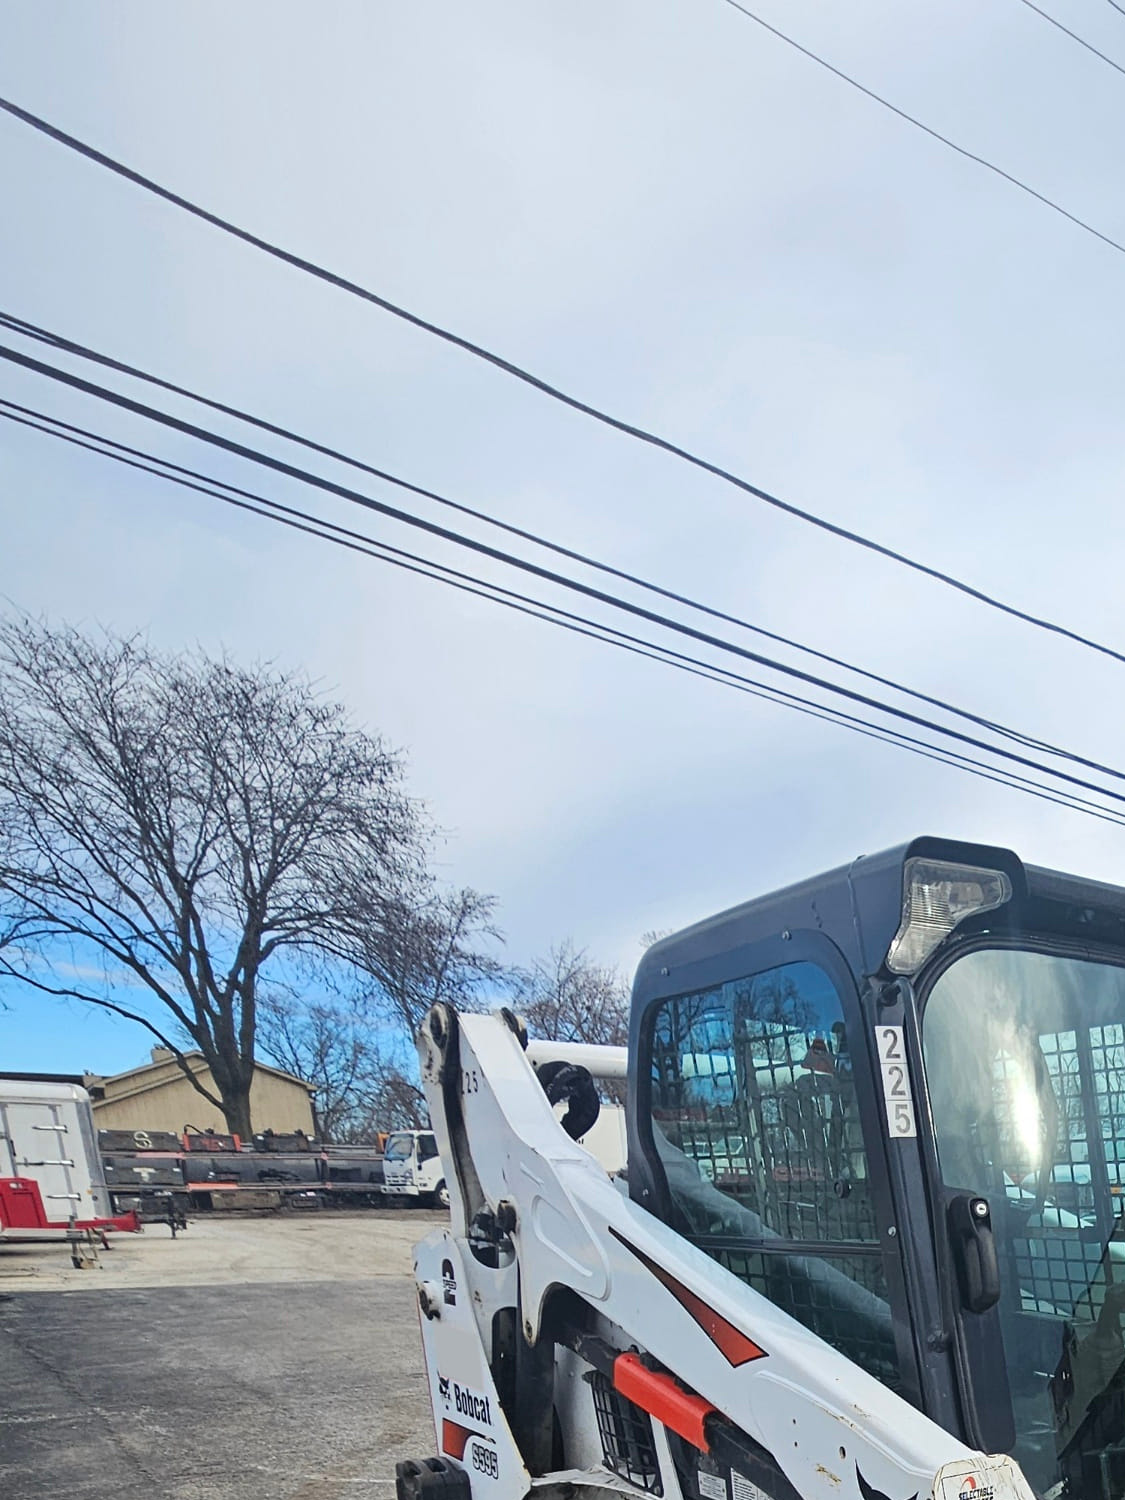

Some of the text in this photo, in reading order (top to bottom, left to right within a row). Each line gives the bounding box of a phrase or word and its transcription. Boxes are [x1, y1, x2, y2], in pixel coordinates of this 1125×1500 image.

[883, 1028, 910, 1134] 225
[453, 1383, 492, 1426] Bobcat
[472, 1442, 499, 1480] S595
